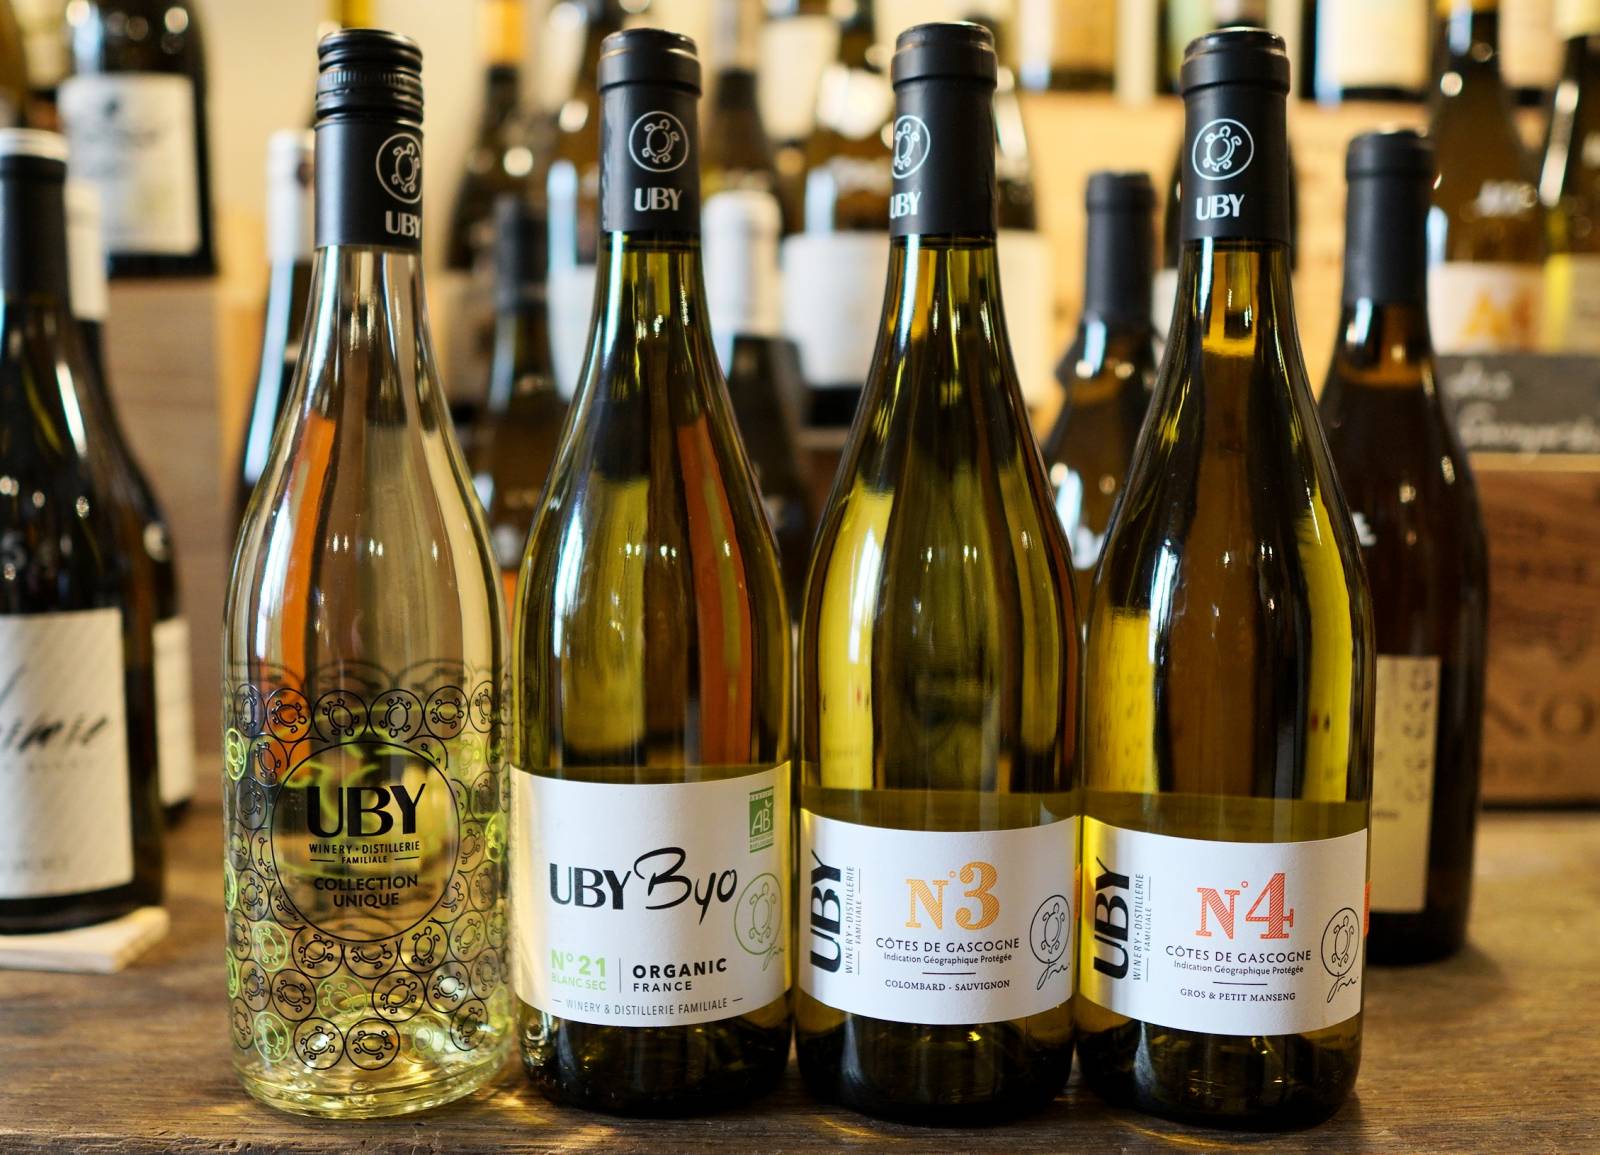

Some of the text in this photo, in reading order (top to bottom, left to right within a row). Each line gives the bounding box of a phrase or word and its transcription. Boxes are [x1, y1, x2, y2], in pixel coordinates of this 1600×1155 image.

[634, 188, 682, 212] UBY
[1196, 193, 1245, 221] UBY
[385, 210, 421, 239] UBY
[307, 784, 426, 838] UBY
[309, 841, 420, 854] WINERY DISTILLERIE
[342, 856, 388, 864] FAMILIALE
[314, 874, 418, 891] COLLECTION
[550, 847, 738, 925] UBY Byo
[334, 892, 399, 908] UNIQUE
[810, 849, 841, 973] UBY
[1094, 857, 1130, 980] UBY
[1132, 872, 1145, 980] WINERY DISTILLERIE
[1144, 908, 1152, 951] FAMILIALE
[845, 932, 854, 974] WINERY
[876, 937, 1020, 952] CÔTES DE GASCOGNE
[884, 952, 1012, 966] Indication Géographique Protégée
[1166, 946, 1312, 964] CÔTES DE GASCOGNE
[633, 958, 727, 978] ORGANIC
[1174, 960, 1304, 976] Indication Géographique Protégée
[552, 973, 606, 991] BLANC SEC
[633, 981, 692, 992] FRANCE
[885, 979, 945, 991] COLOMBARD
[955, 979, 1010, 991] SAUVIGNON
[1180, 988, 1296, 1001] GROS & PETIT MANSENG
[567, 998, 727, 1015] WINERY & DISTILLERIE FAMILIALE
